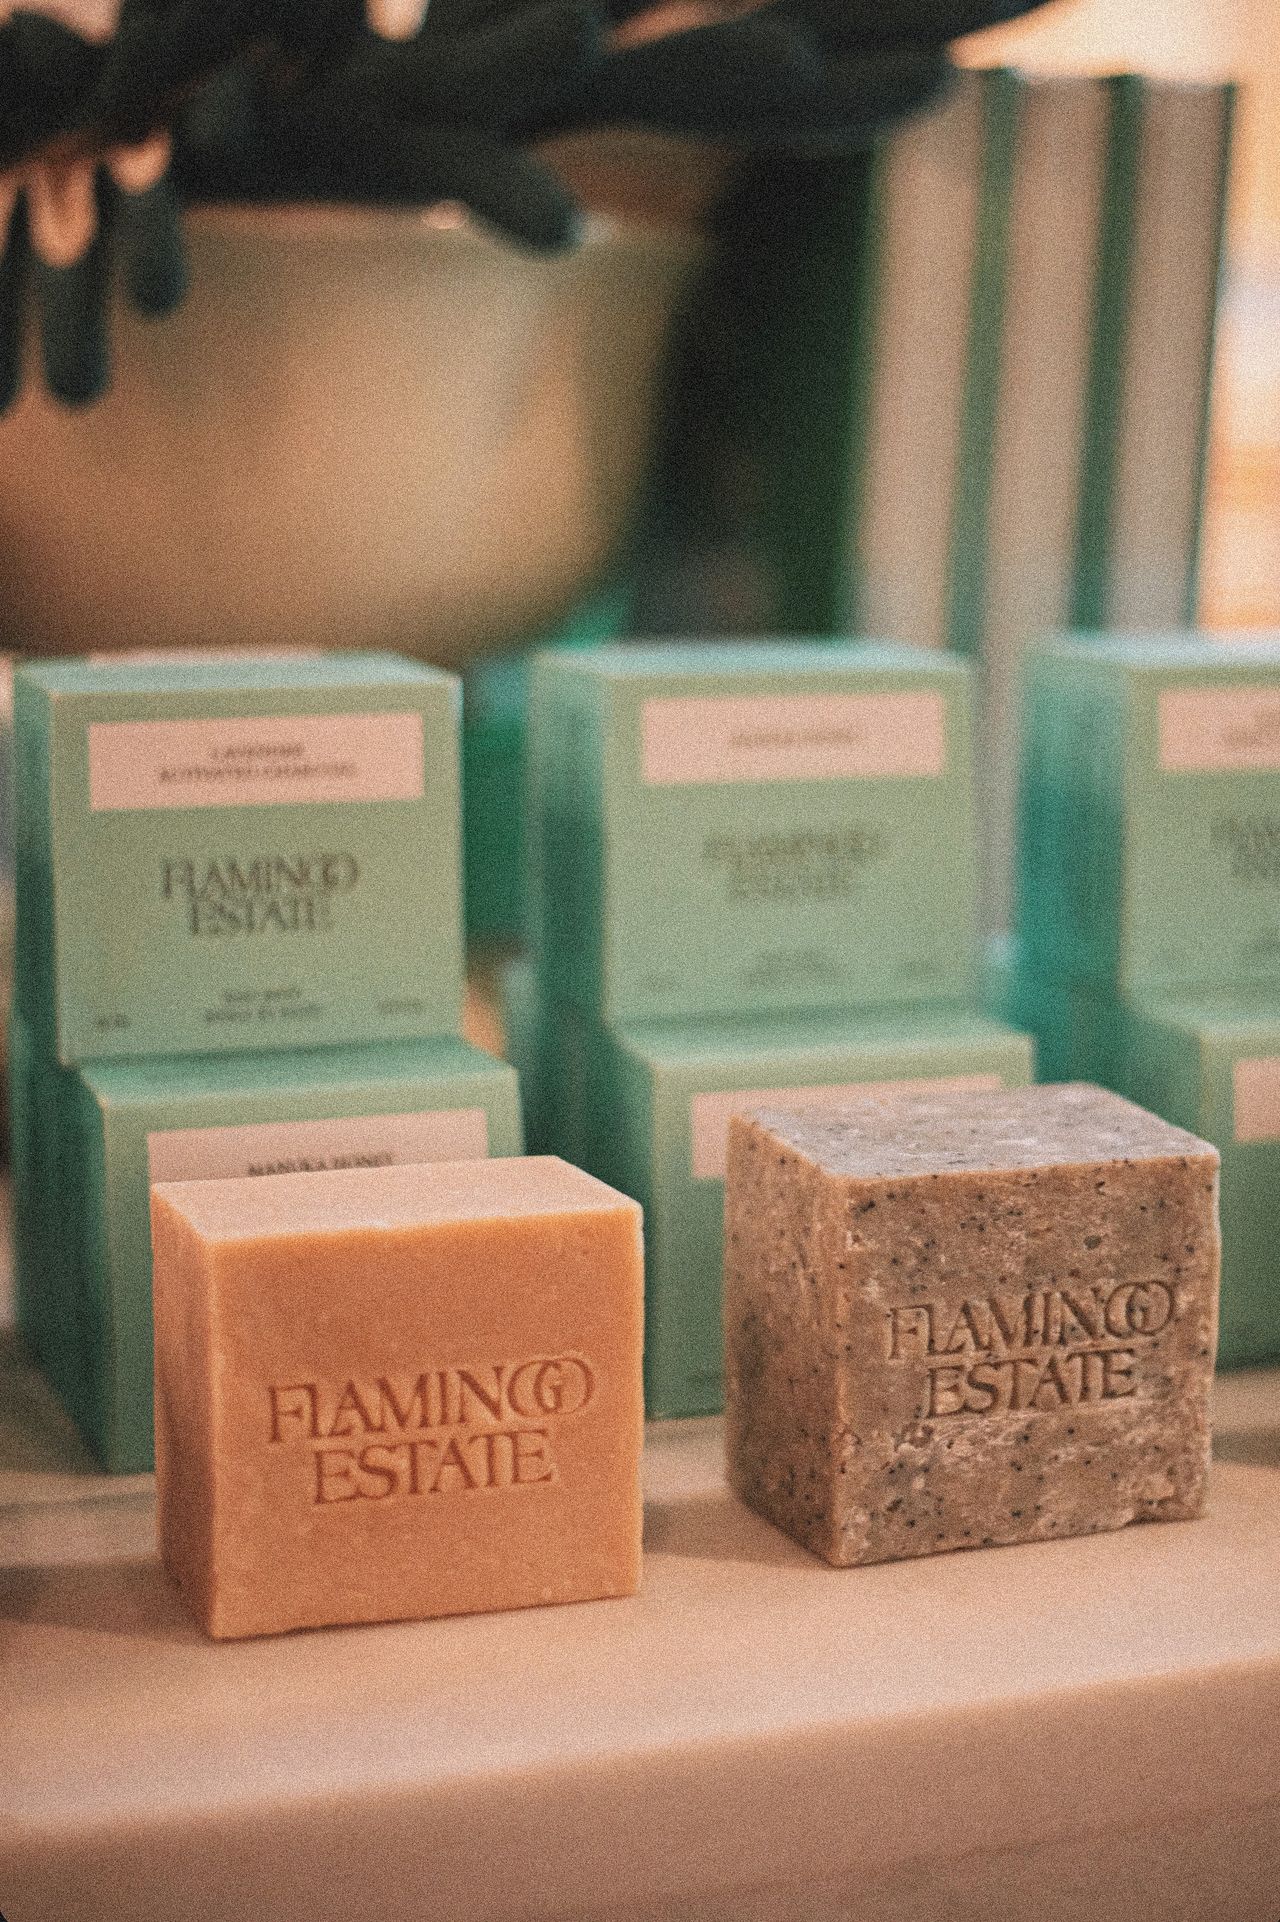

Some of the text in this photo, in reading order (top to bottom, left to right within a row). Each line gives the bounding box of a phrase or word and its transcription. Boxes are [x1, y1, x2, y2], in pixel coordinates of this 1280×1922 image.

[162, 852, 359, 899] FLAMINGO
[190, 896, 334, 936] ESTATE
[886, 1280, 1175, 1359] FLAMINGO
[268, 1356, 595, 1443] FLAMINGO
[926, 1348, 1138, 1418] ESTATE
[313, 1428, 553, 1505] ESTATE
